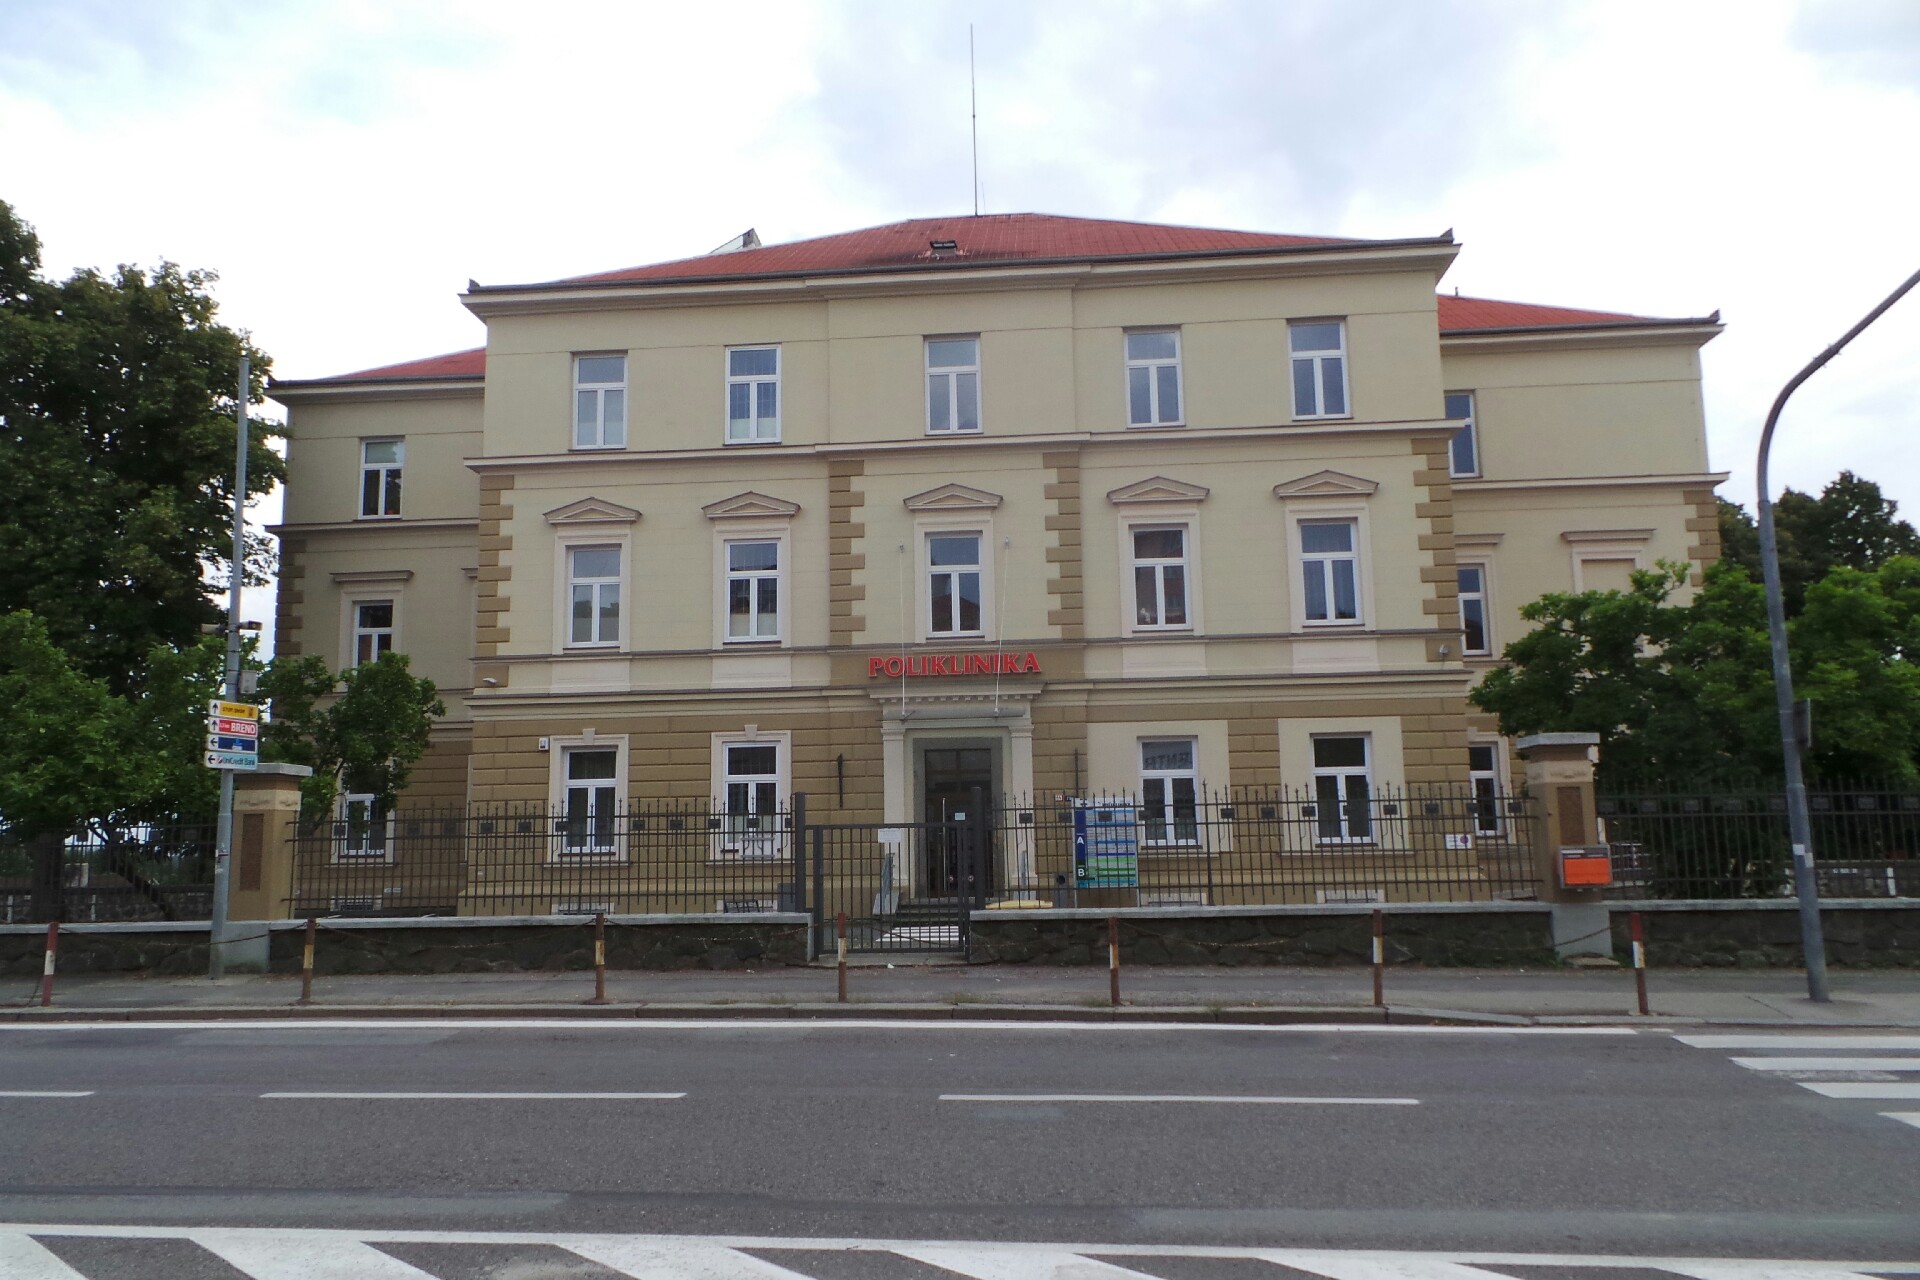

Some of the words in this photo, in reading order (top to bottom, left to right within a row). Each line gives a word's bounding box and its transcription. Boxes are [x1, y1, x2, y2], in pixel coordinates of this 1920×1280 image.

[868, 652, 1041, 677] POLIKLINIKA
[231, 723, 255, 734] BRENO
[1077, 836, 1084, 845] A
[1078, 868, 1085, 877] B
